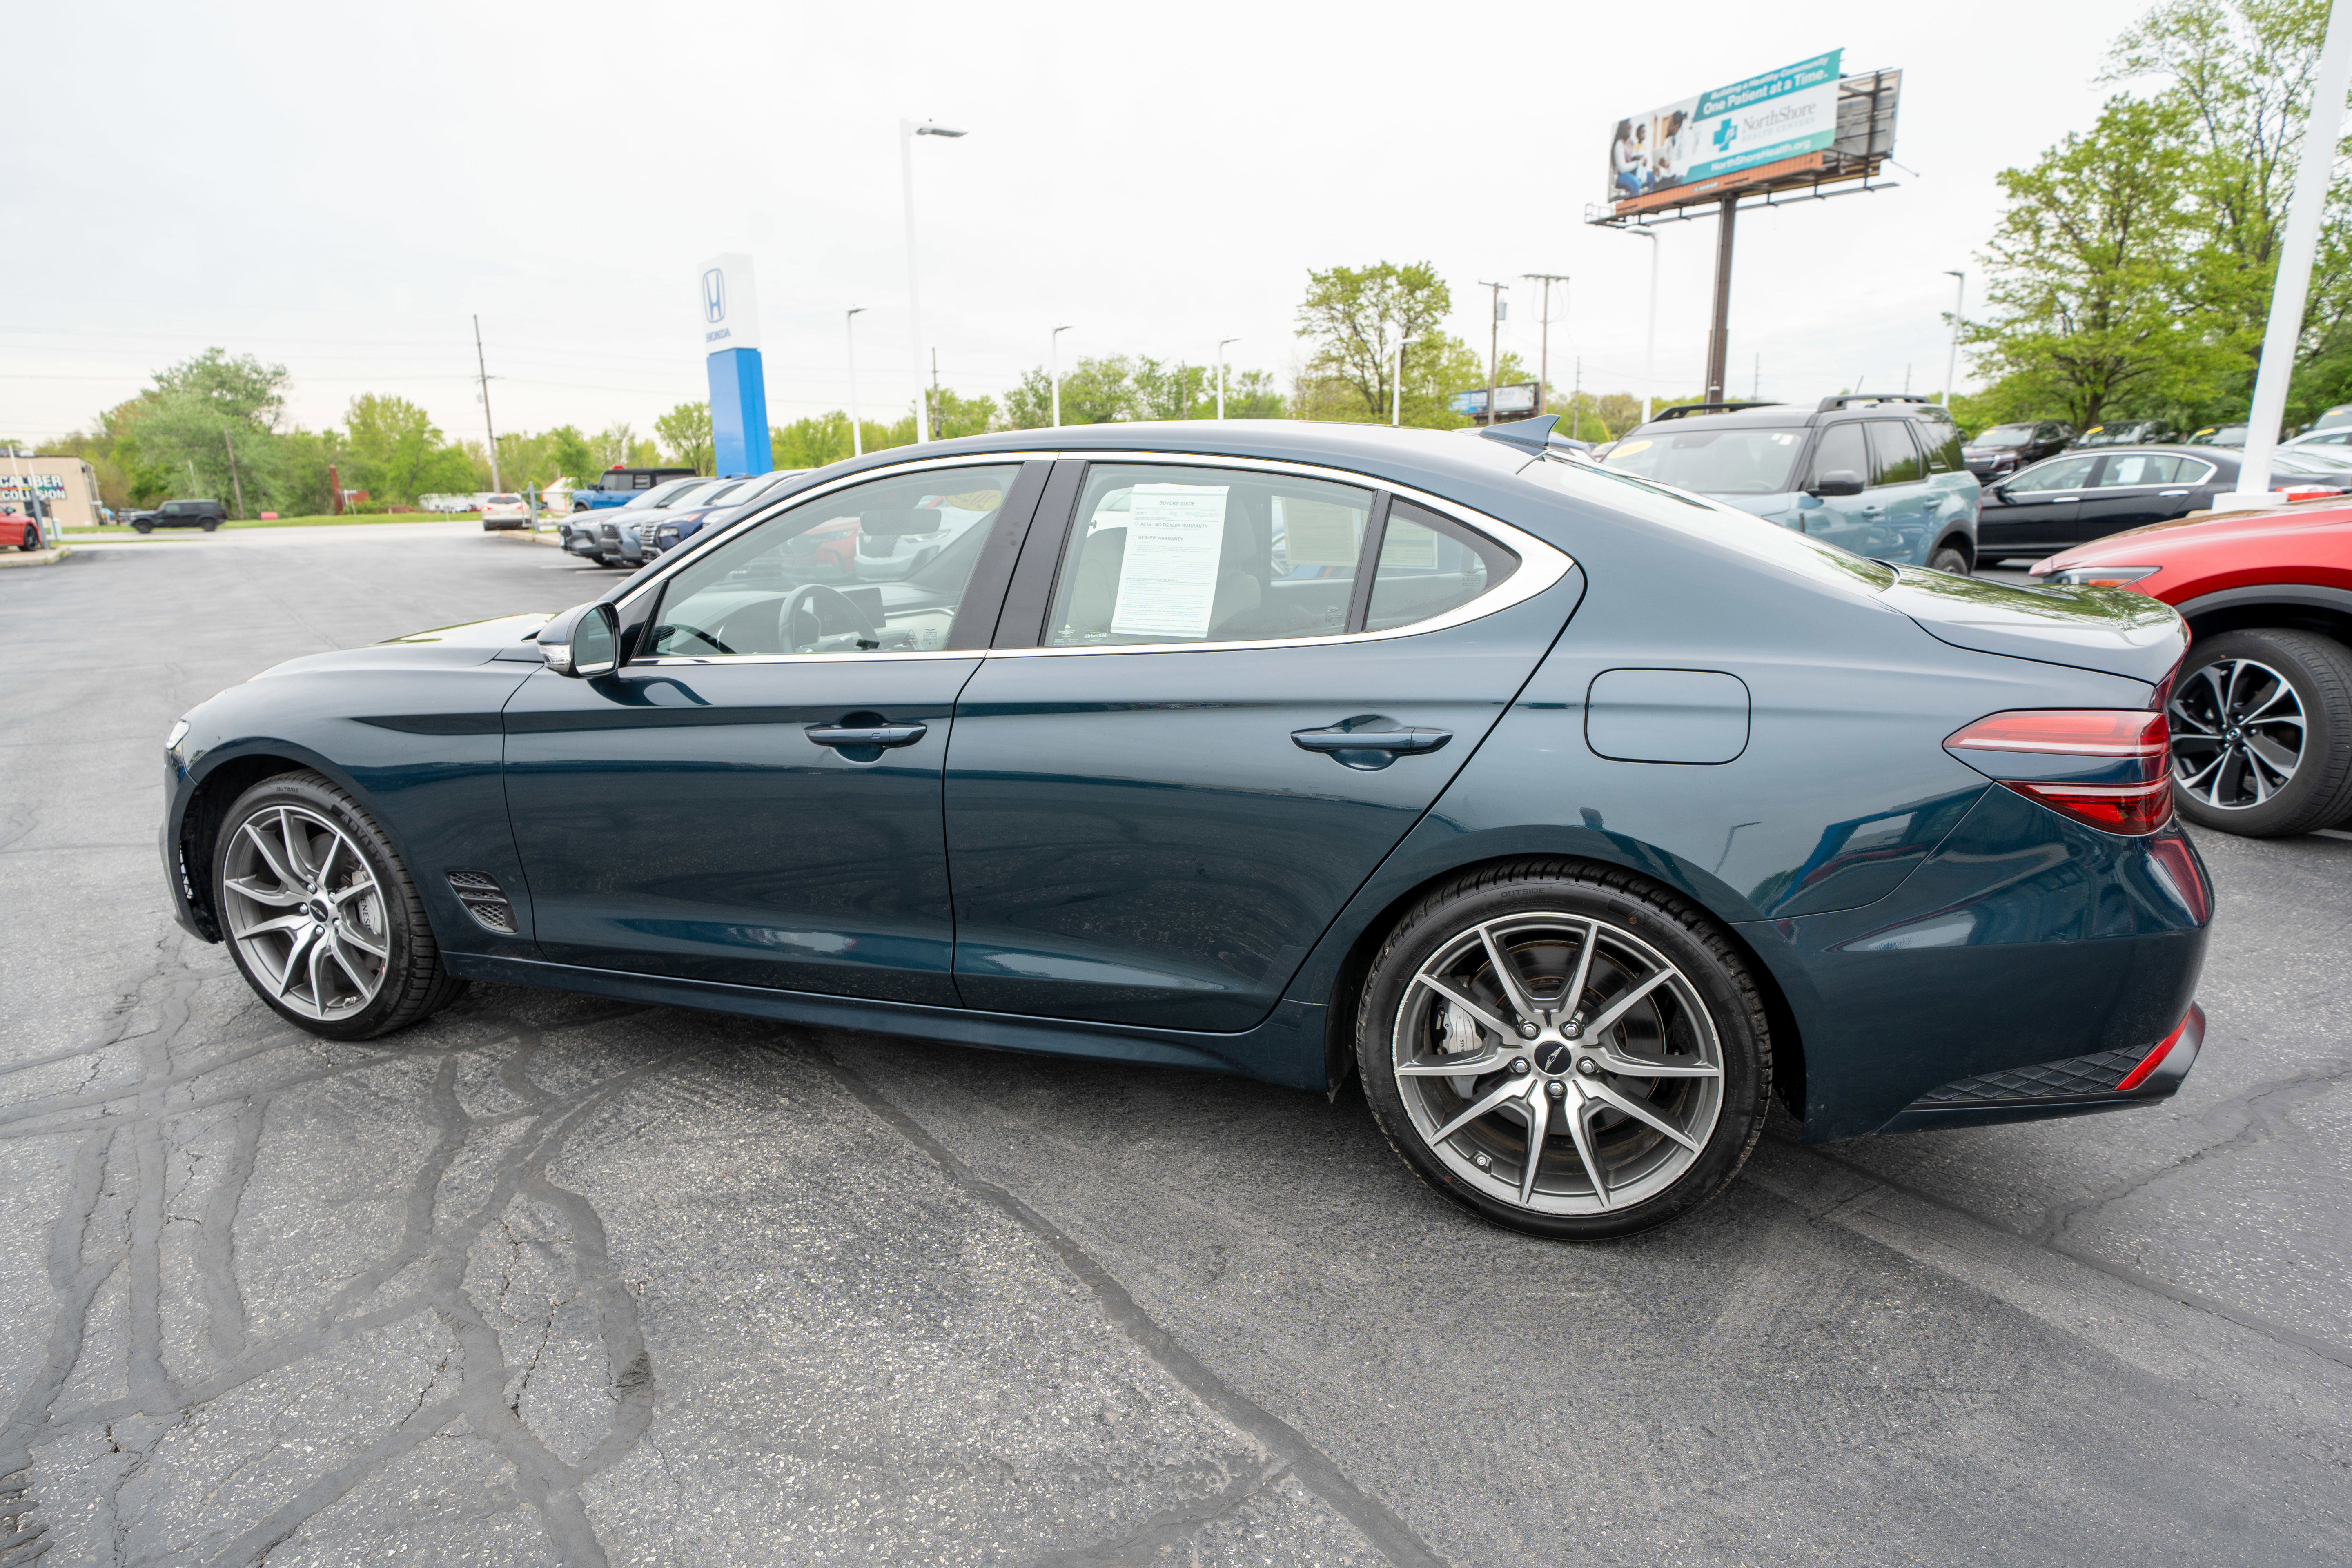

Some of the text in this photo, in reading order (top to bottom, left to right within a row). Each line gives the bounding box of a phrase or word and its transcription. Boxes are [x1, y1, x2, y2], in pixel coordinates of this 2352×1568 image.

[1703, 69, 1829, 115] One Patient at a Time.
[1710, 56, 1829, 100] Building a Healthy Community
[1742, 103, 1817, 133] NorthShore
[1711, 139, 1811, 171] NorthShoreHealth.org
[706, 328, 731, 343] HONDA
[0, 475, 64, 488] CALIBER
[340, 813, 389, 871] ADVANTA
[1501, 888, 1545, 898] OUTSIDE
[361, 898, 372, 931] ENESI
